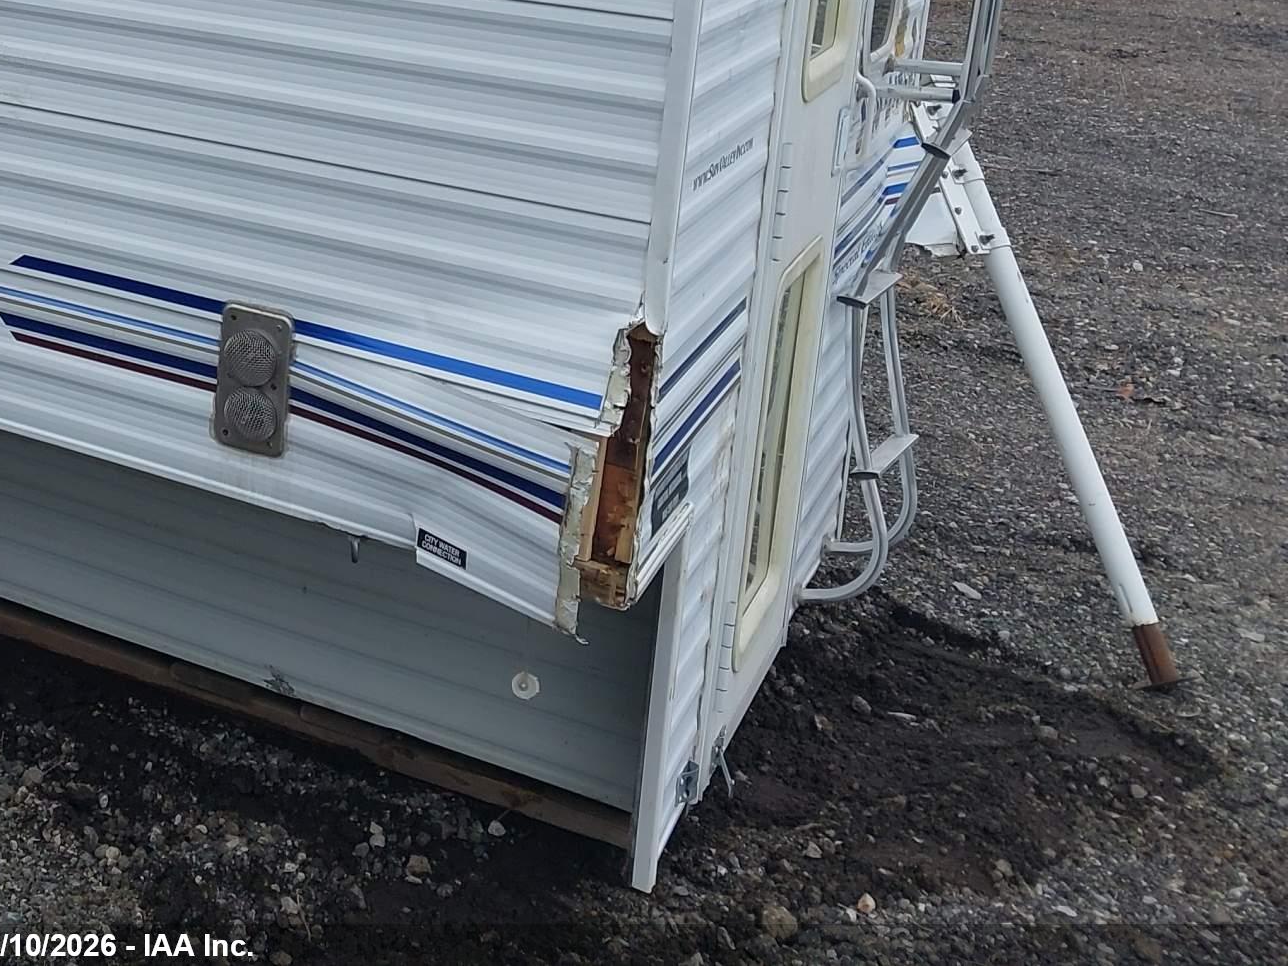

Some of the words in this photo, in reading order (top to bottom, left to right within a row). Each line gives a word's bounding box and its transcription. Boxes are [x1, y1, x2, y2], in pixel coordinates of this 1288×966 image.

[421, 540, 462, 565] CONNECTION
[424, 533, 439, 546] CITY
[438, 541, 460, 557] WATER
